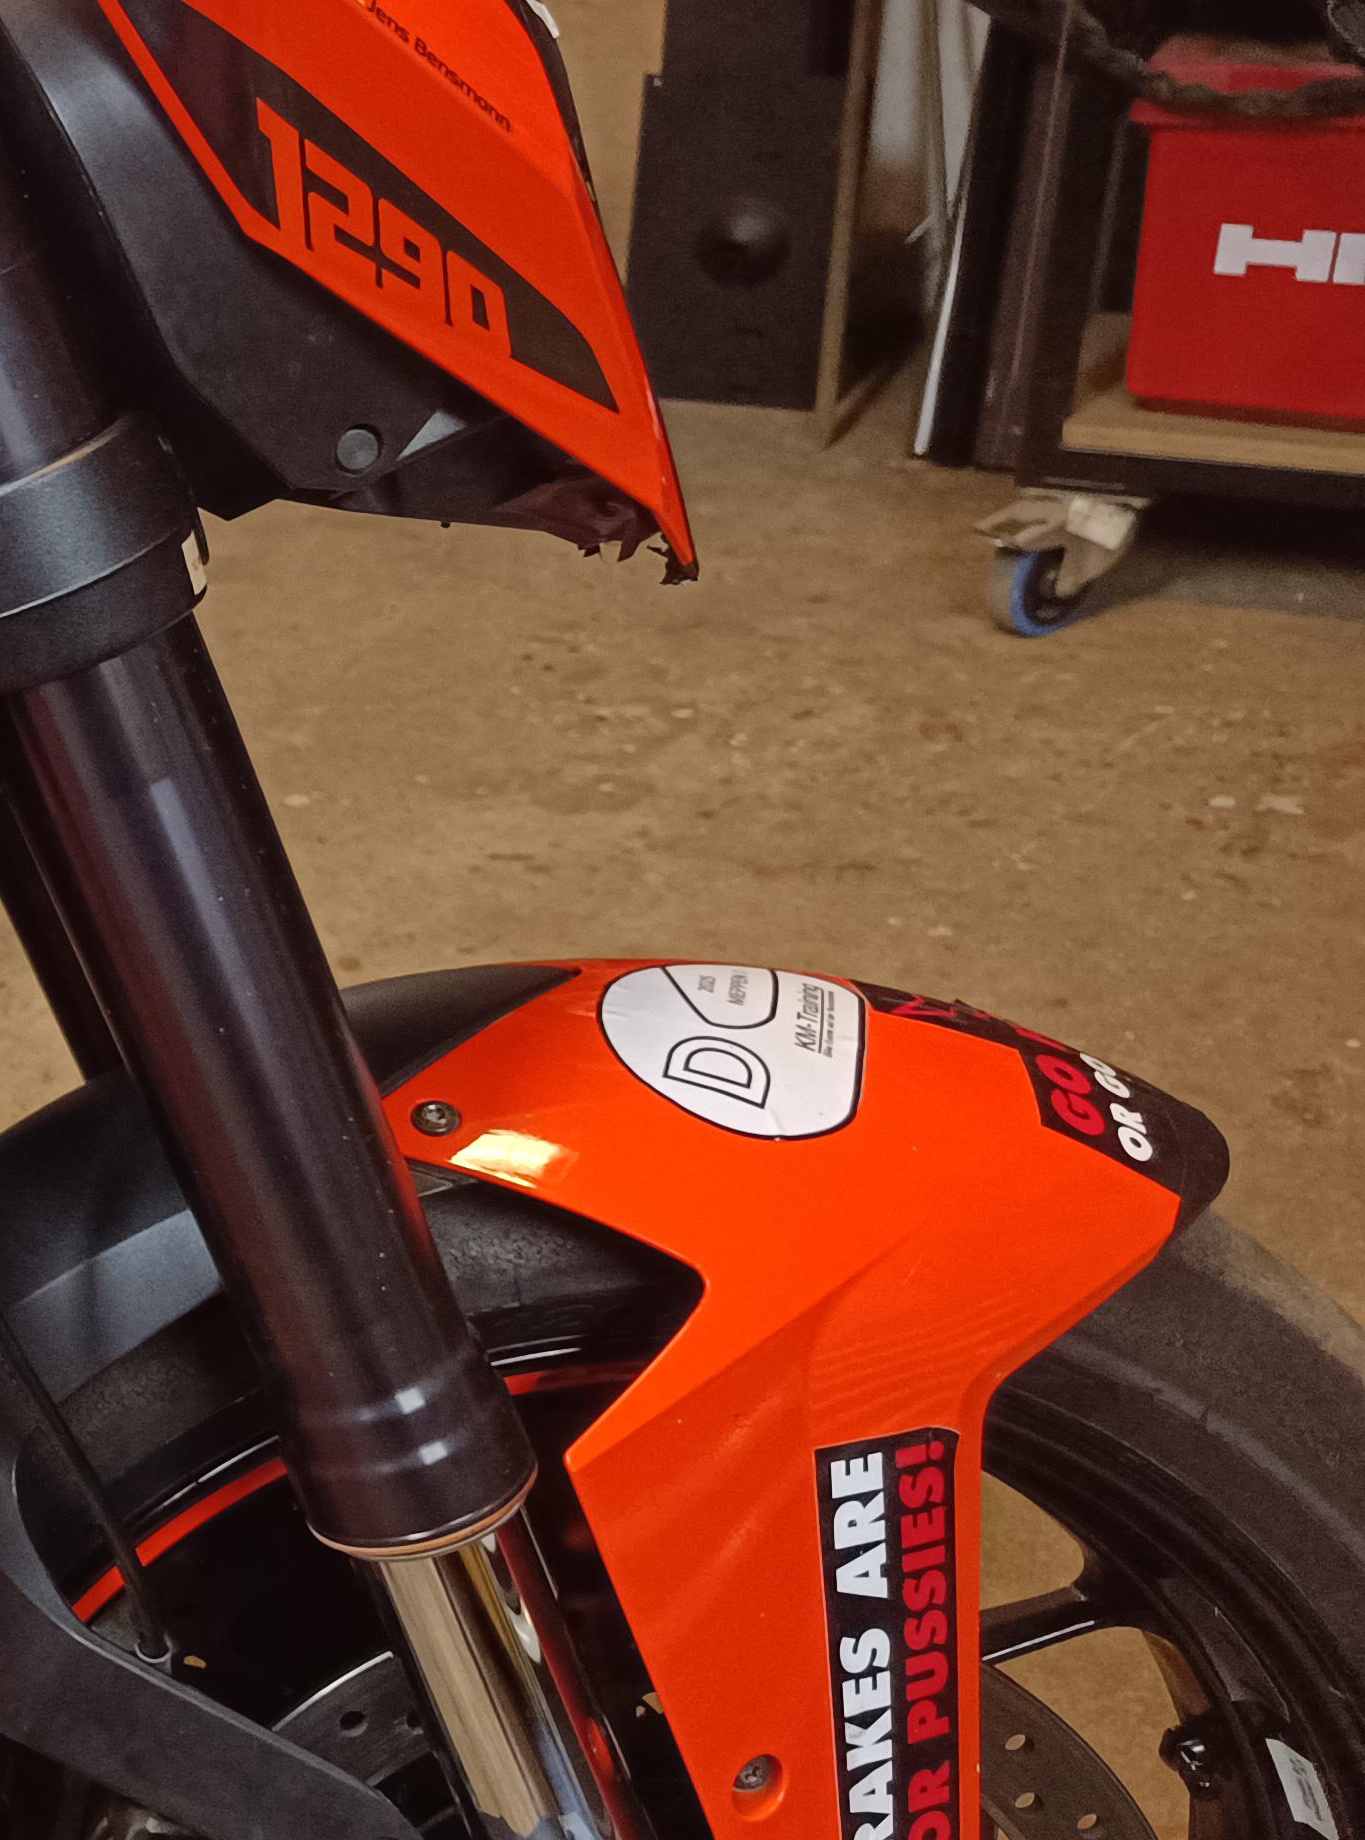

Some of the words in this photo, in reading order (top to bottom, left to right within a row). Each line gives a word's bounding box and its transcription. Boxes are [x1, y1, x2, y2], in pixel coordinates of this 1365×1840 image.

[366, 0, 411, 44] Jens
[256, 97, 513, 360] 1290
[1213, 222, 1365, 285] HI
[662, 1035, 772, 1110] D
[1035, 1053, 1107, 1136] GO
[1079, 1052, 1131, 1099] GO
[1109, 1102, 1154, 1162] OR
[829, 1451, 889, 1600] ARE
[894, 1440, 952, 1746] PUSSIES!
